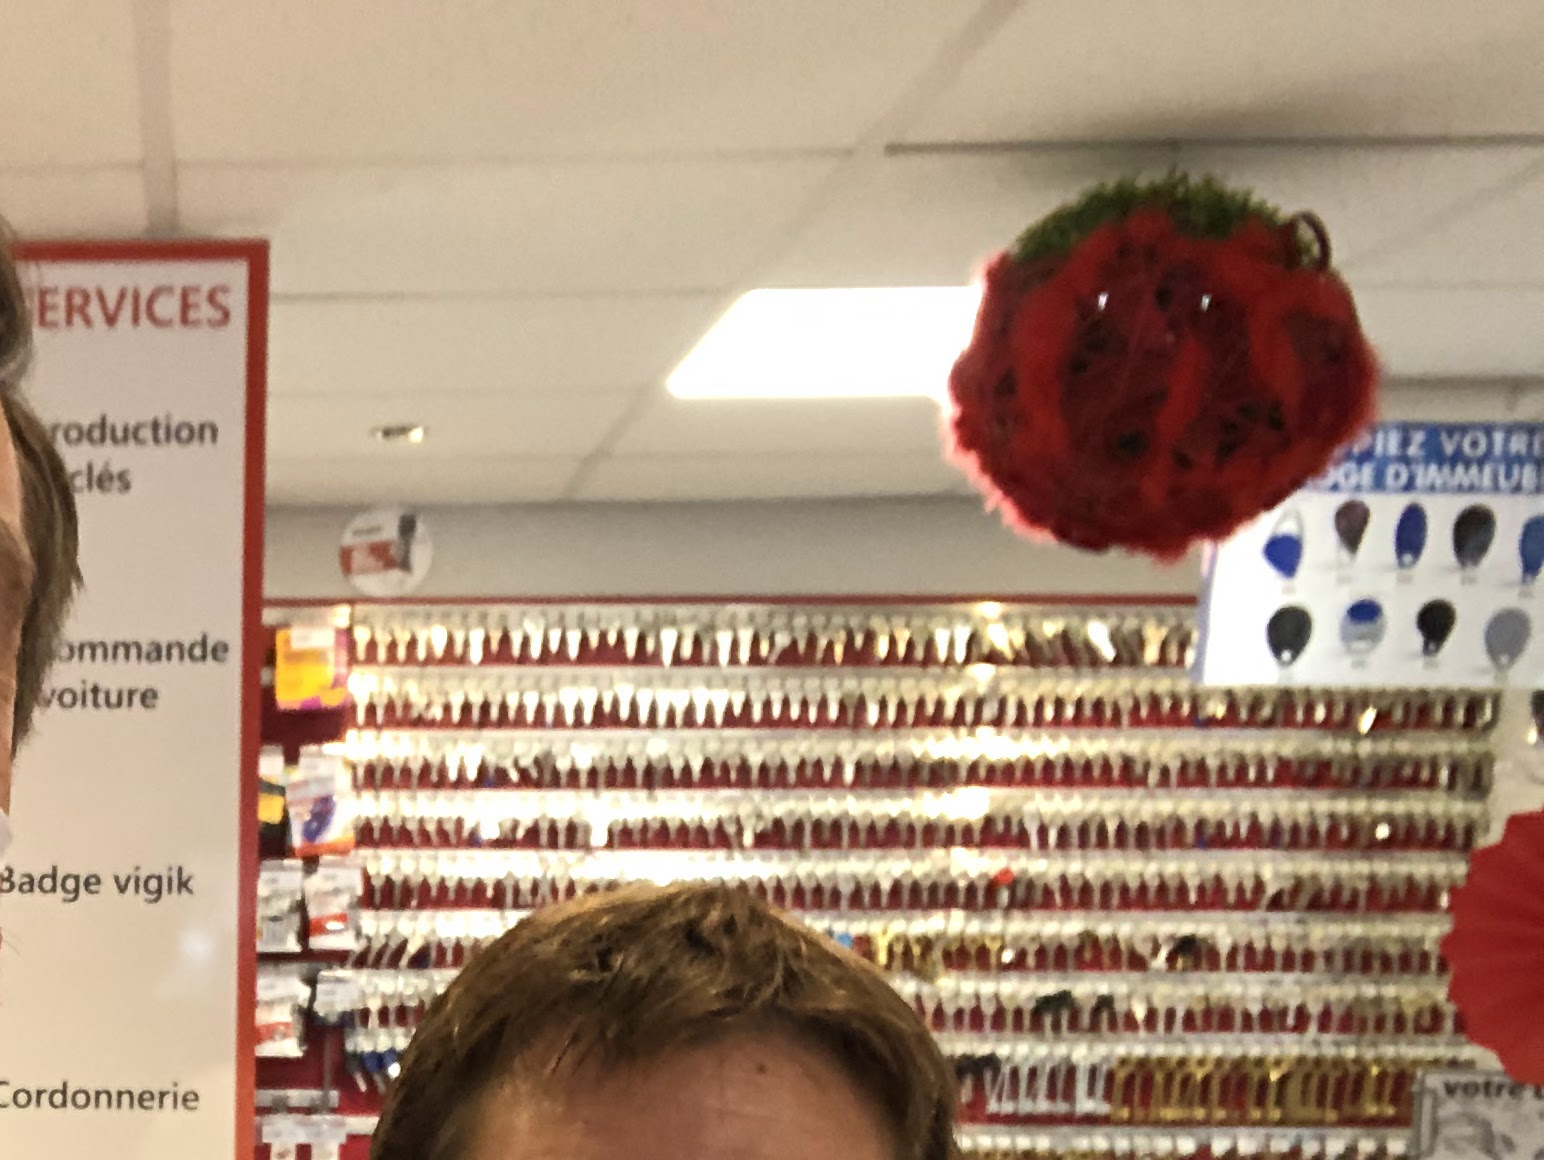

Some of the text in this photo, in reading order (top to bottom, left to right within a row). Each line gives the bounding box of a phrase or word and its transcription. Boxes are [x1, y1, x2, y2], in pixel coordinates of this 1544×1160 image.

[51, 412, 219, 445] roduction
[70, 459, 132, 494] clés
[58, 631, 230, 663] ommande
[38, 680, 160, 709] voiture
[0, 865, 195, 904] Badge vigik
